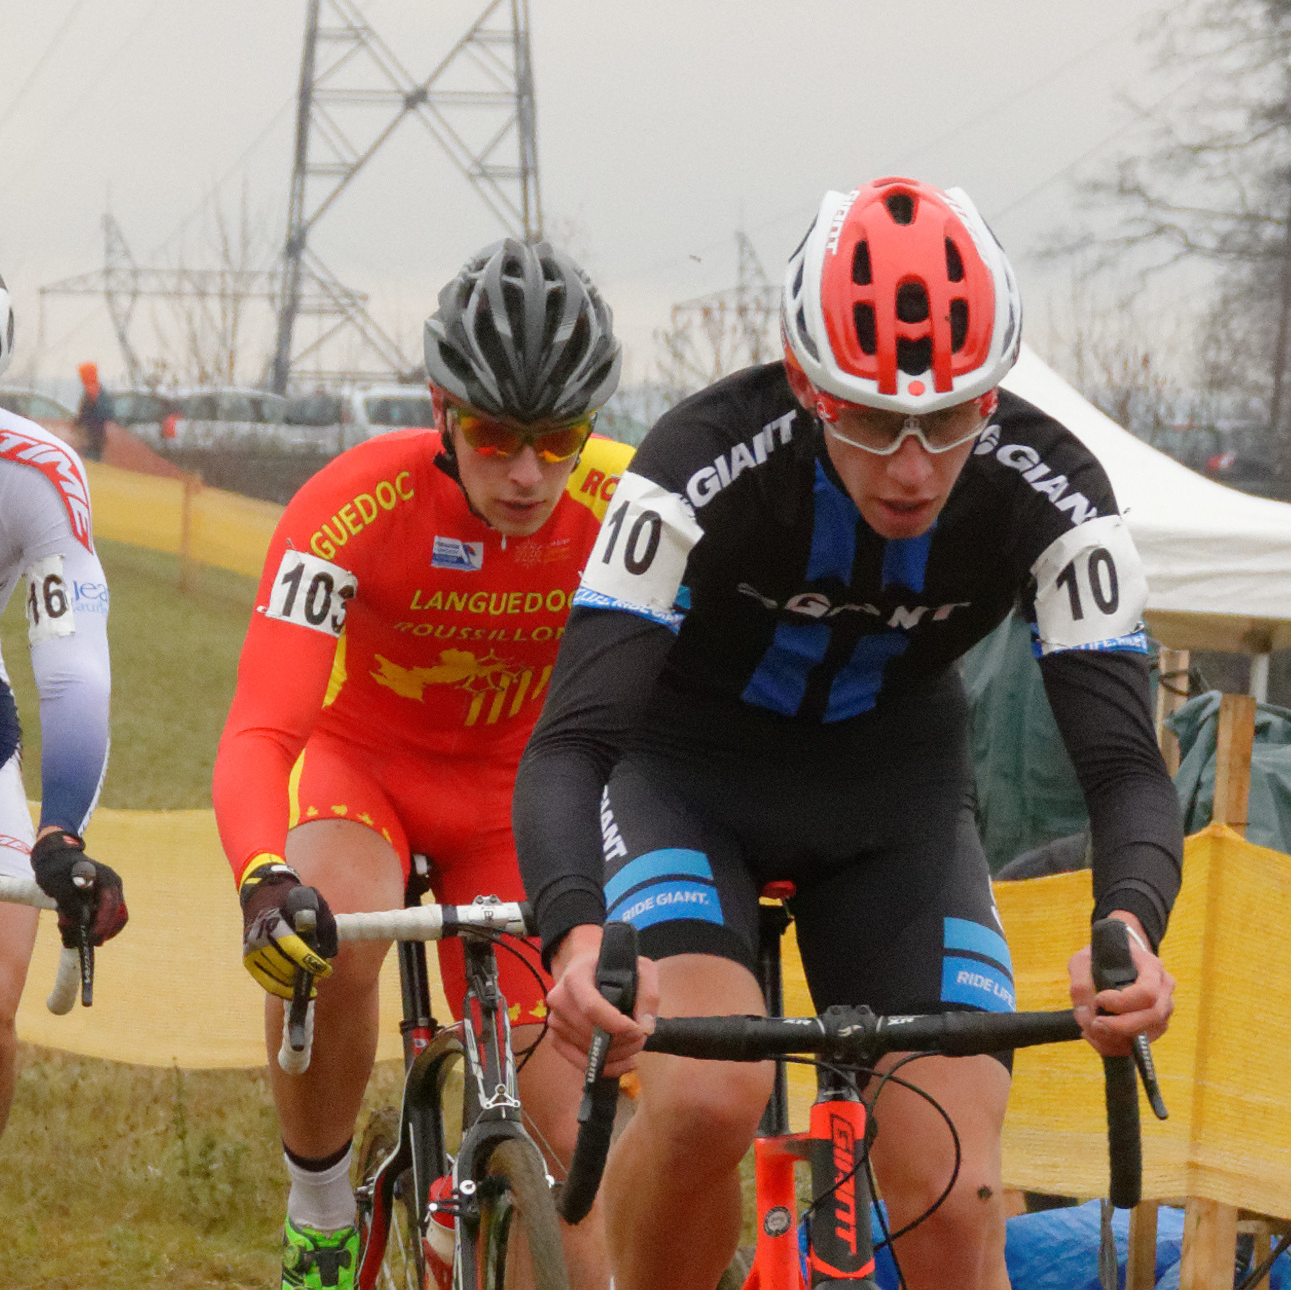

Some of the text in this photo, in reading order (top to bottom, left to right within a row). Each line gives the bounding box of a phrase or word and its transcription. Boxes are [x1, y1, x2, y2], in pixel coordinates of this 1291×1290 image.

[685, 410, 799, 508] GIANT
[996, 443, 1099, 526] GIAN
[304, 471, 416, 562] GUEDOC
[600, 500, 661, 576] 10
[28, 573, 68, 626] 16
[1056, 548, 1119, 621] 10
[622, 897, 655, 922] RIDE
[956, 970, 995, 992] RIDE
[828, 1113, 859, 1257] GIANT
